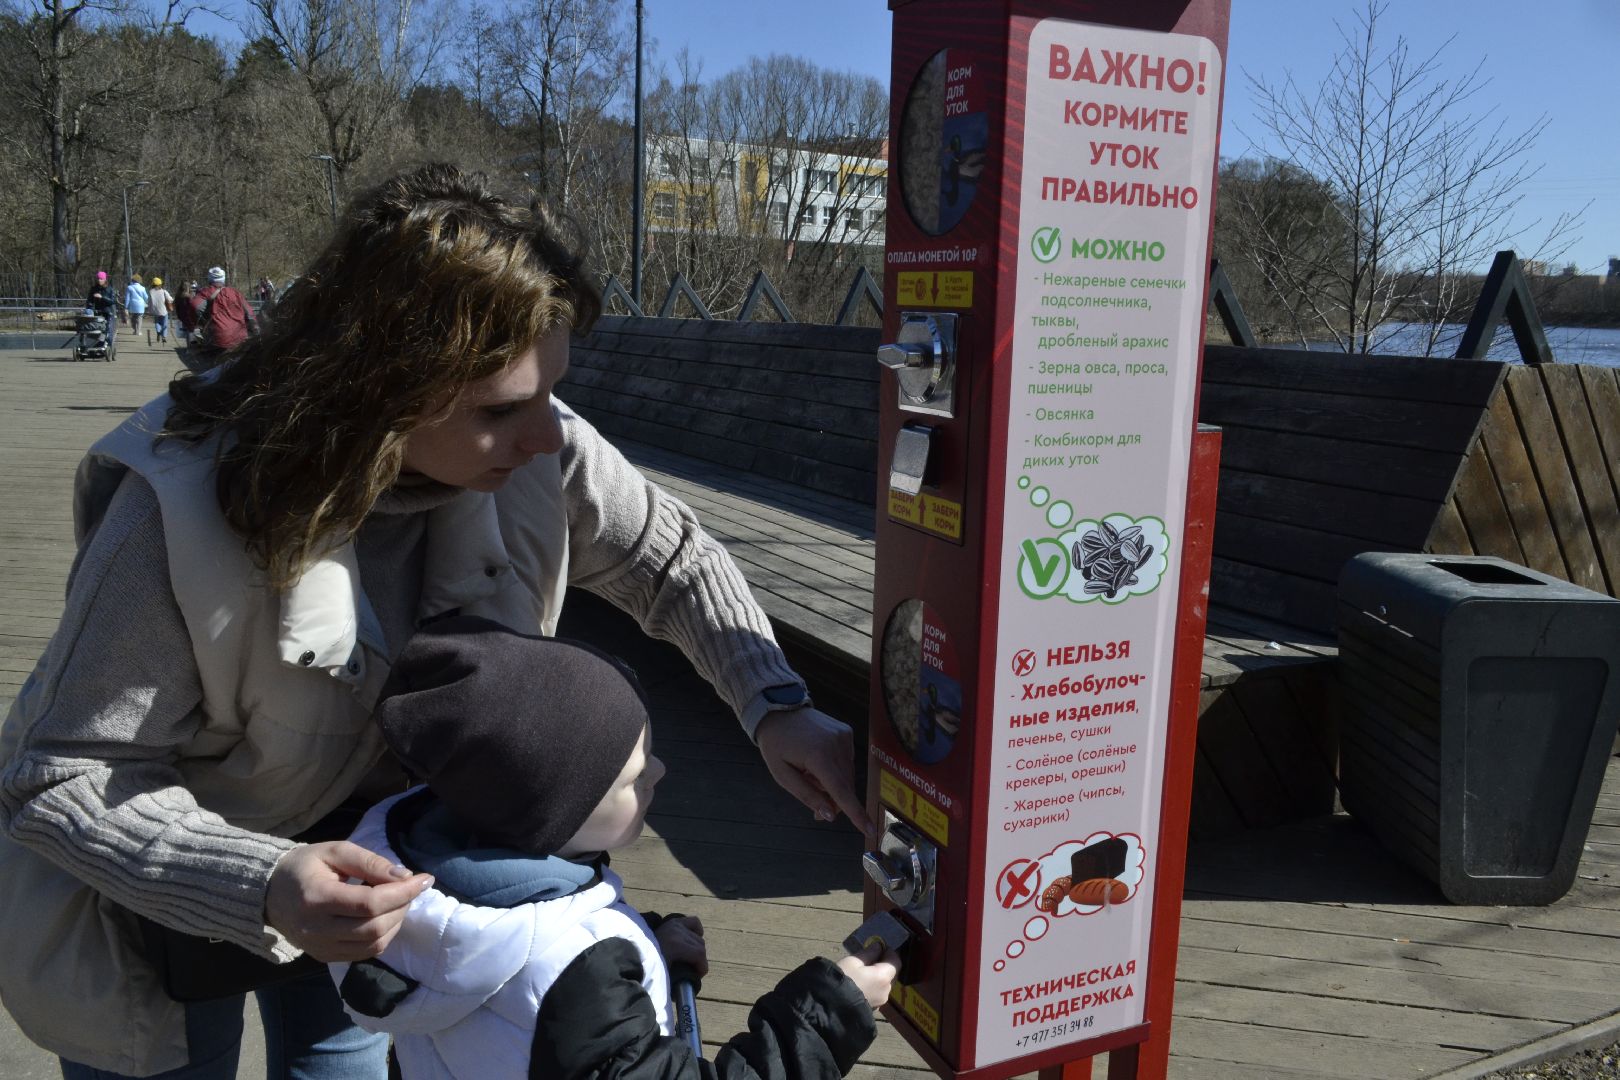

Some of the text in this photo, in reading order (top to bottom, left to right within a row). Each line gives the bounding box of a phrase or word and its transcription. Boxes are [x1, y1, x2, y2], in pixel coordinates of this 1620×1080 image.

[948, 66, 972, 83] КОРМ
[1049, 43, 1207, 96] ВАЖНО!
[946, 84, 964, 101] ДЛЯ
[946, 100, 968, 116] УТОК
[1064, 99, 1188, 135] КОРМИТЕ
[1089, 141, 1160, 170] УТОК
[1041, 176, 1198, 210] ПРАВИЛЬНО
[887, 251, 916, 263] ОПЛАТА
[918, 246, 960, 263] МОНЕТОЙ
[1071, 237, 1166, 262] МОЖНО
[1043, 272, 1126, 290] Нежареные
[1130, 276, 1186, 290] семечки
[1040, 295, 1152, 311] подсолнечника,
[1031, 315, 1079, 329] тыквы,
[1038, 333, 1169, 350] дробленый арахис
[1038, 361, 1080, 376] Зерна
[1084, 362, 1120, 376] овса,
[1125, 361, 1168, 376] проса,
[1027, 383, 1093, 397] пшеницы
[1035, 407, 1094, 421] Овсянка
[1034, 432, 1113, 448] Комбикорм
[1116, 433, 1141, 447] для
[1022, 454, 1099, 470] диких уток
[932, 502, 959, 520] ЗАБЕРИ
[924, 623, 946, 642] КОРМ
[923, 638, 940, 654] ДЛЯ
[1046, 640, 1131, 667] НЕЛЬЗЯ
[923, 652, 944, 671] УТОК
[1020, 673, 1146, 701] Хлебобулоч-
[1009, 699, 1139, 729] ные изделия,
[1008, 724, 1111, 749] печенье, сушки
[1015, 753, 1074, 771] Солёное
[1077, 743, 1137, 763] (солёные
[870, 744, 898, 771] ОПЛАТА
[899, 763, 936, 799] МОНЕТОЙ
[1005, 760, 1126, 791] крекеры, орешки)
[1013, 791, 1074, 813] Жареное
[1078, 784, 1125, 802] (чипсы,
[1003, 809, 1070, 833] сухарики)
[1000, 959, 1136, 1006] ТЕХНИЧЕСКАЯ
[1012, 984, 1134, 1027] ПОДДЕРЖКА
